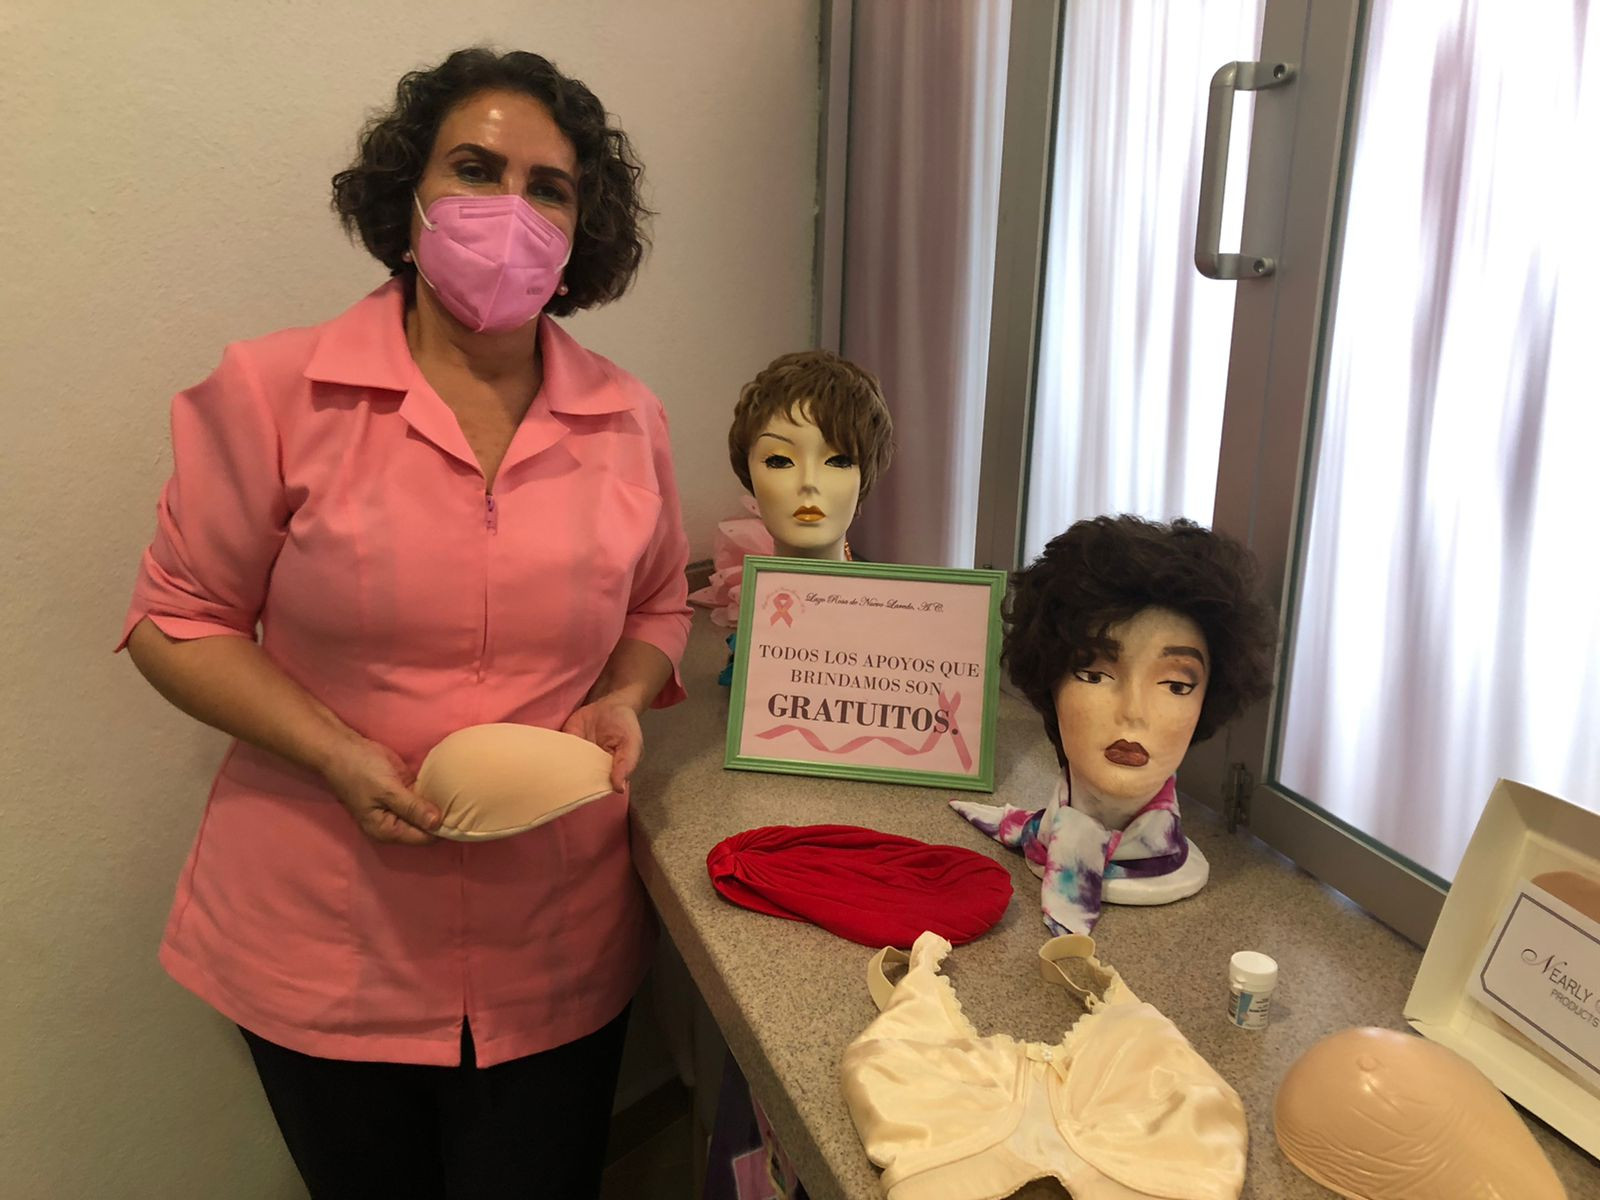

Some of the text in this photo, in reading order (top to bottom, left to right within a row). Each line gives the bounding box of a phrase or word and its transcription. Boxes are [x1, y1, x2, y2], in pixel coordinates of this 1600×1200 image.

[759, 644, 980, 679] TODOS LOS APOYOS QUE
[791, 668, 942, 696] BRINDAMOS SON
[767, 693, 959, 735] GRATUITOS.
[1550, 988, 1600, 1028] PRODUCTS
